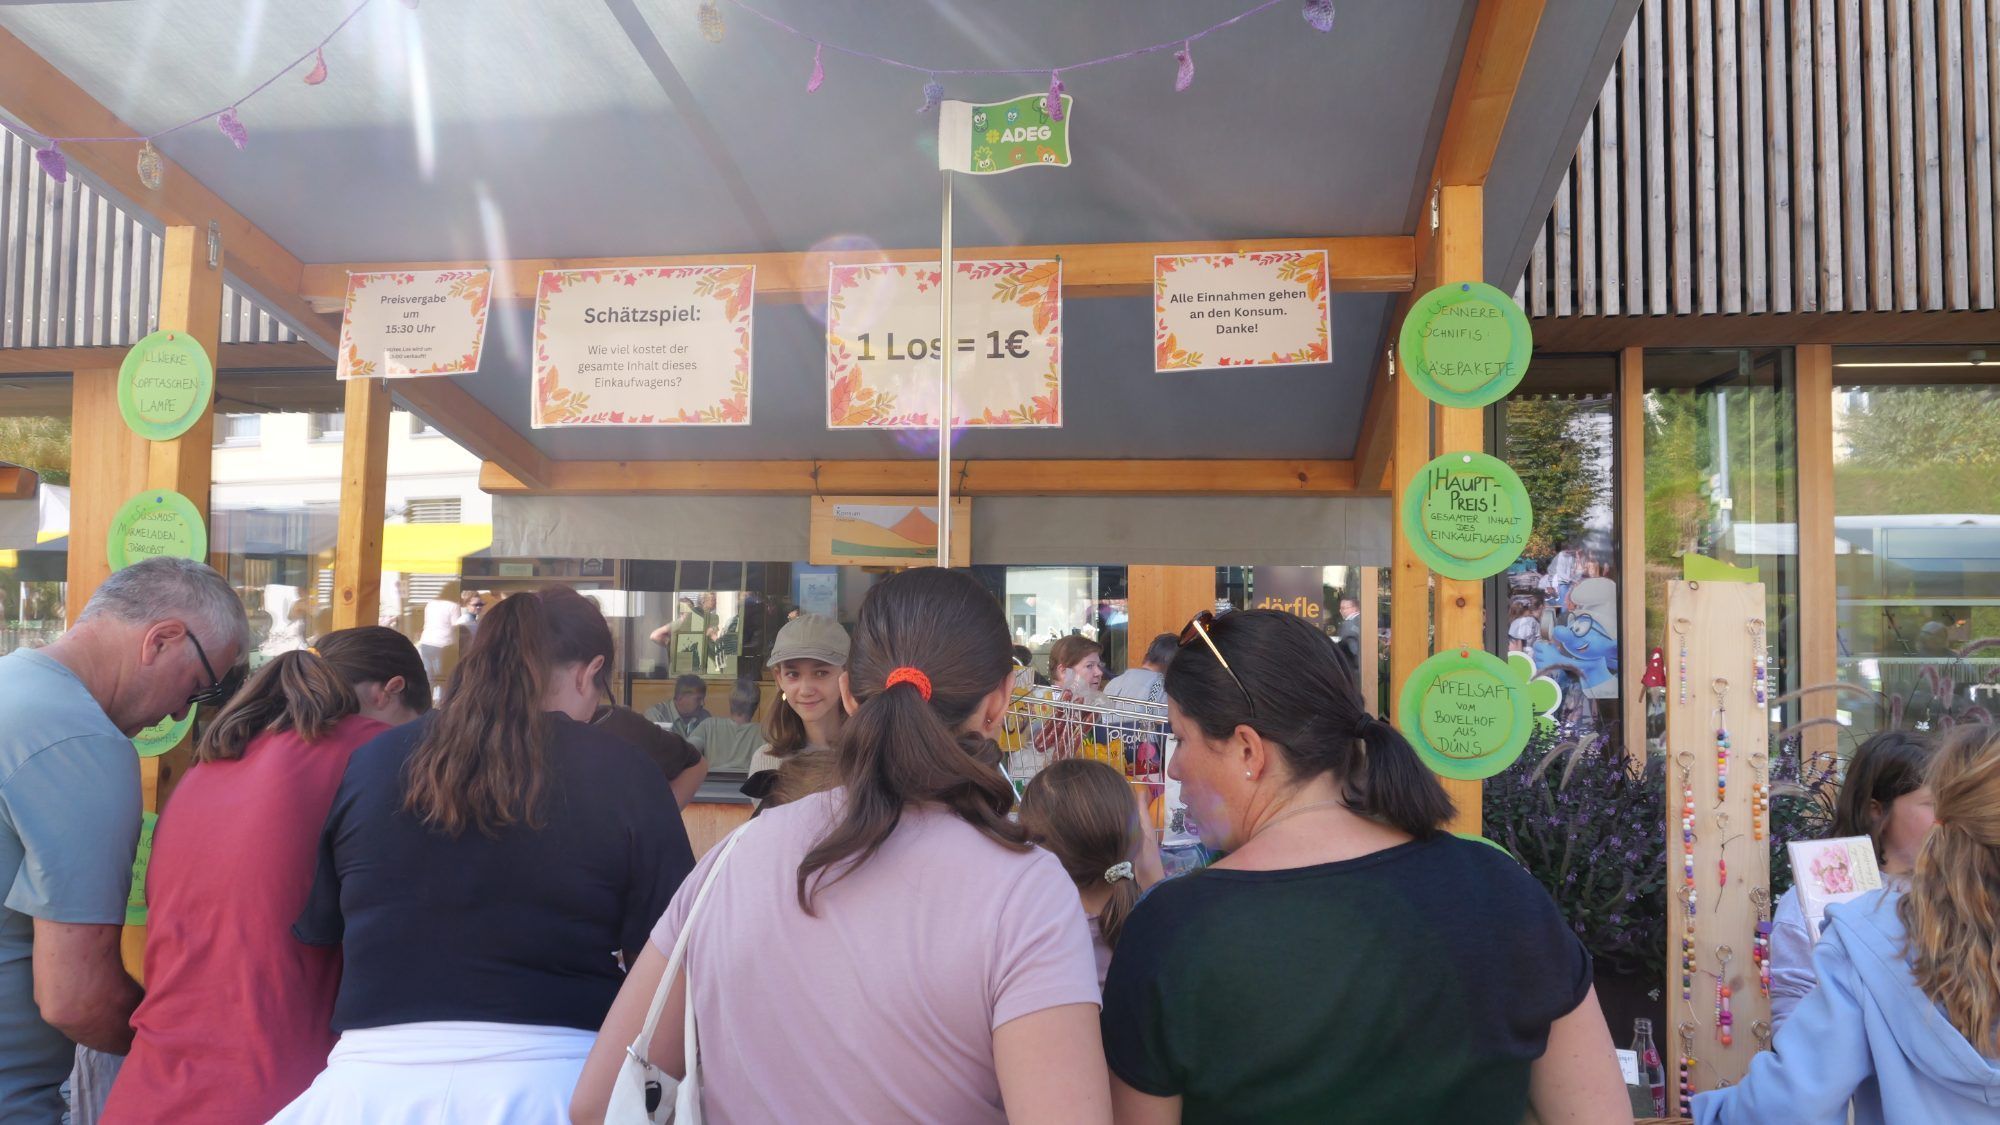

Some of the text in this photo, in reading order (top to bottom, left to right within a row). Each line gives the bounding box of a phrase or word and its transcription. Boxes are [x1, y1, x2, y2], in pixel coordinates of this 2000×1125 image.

[1000, 125, 1052, 143] ADEG
[381, 294, 447, 306] Preisvergabe
[1170, 289, 1306, 304] Alle Einnahmen gehen
[403, 310, 419, 318] um
[584, 305, 701, 326] Schätzspiel:
[1190, 306, 1287, 319] an den Konsum.
[385, 323, 436, 334] 15:30 Uhr
[1216, 323, 1258, 334] Danke!
[588, 344, 688, 355] Wie viel kostet der
[857, 330, 1030, 361] 1 Los = 1€
[578, 360, 697, 374] gesamte Inhalt dieses
[594, 376, 682, 390] Einkaufwagens?
[1426, 674, 1517, 700] APFELSAFT
[1453, 727, 1477, 737] AUS
